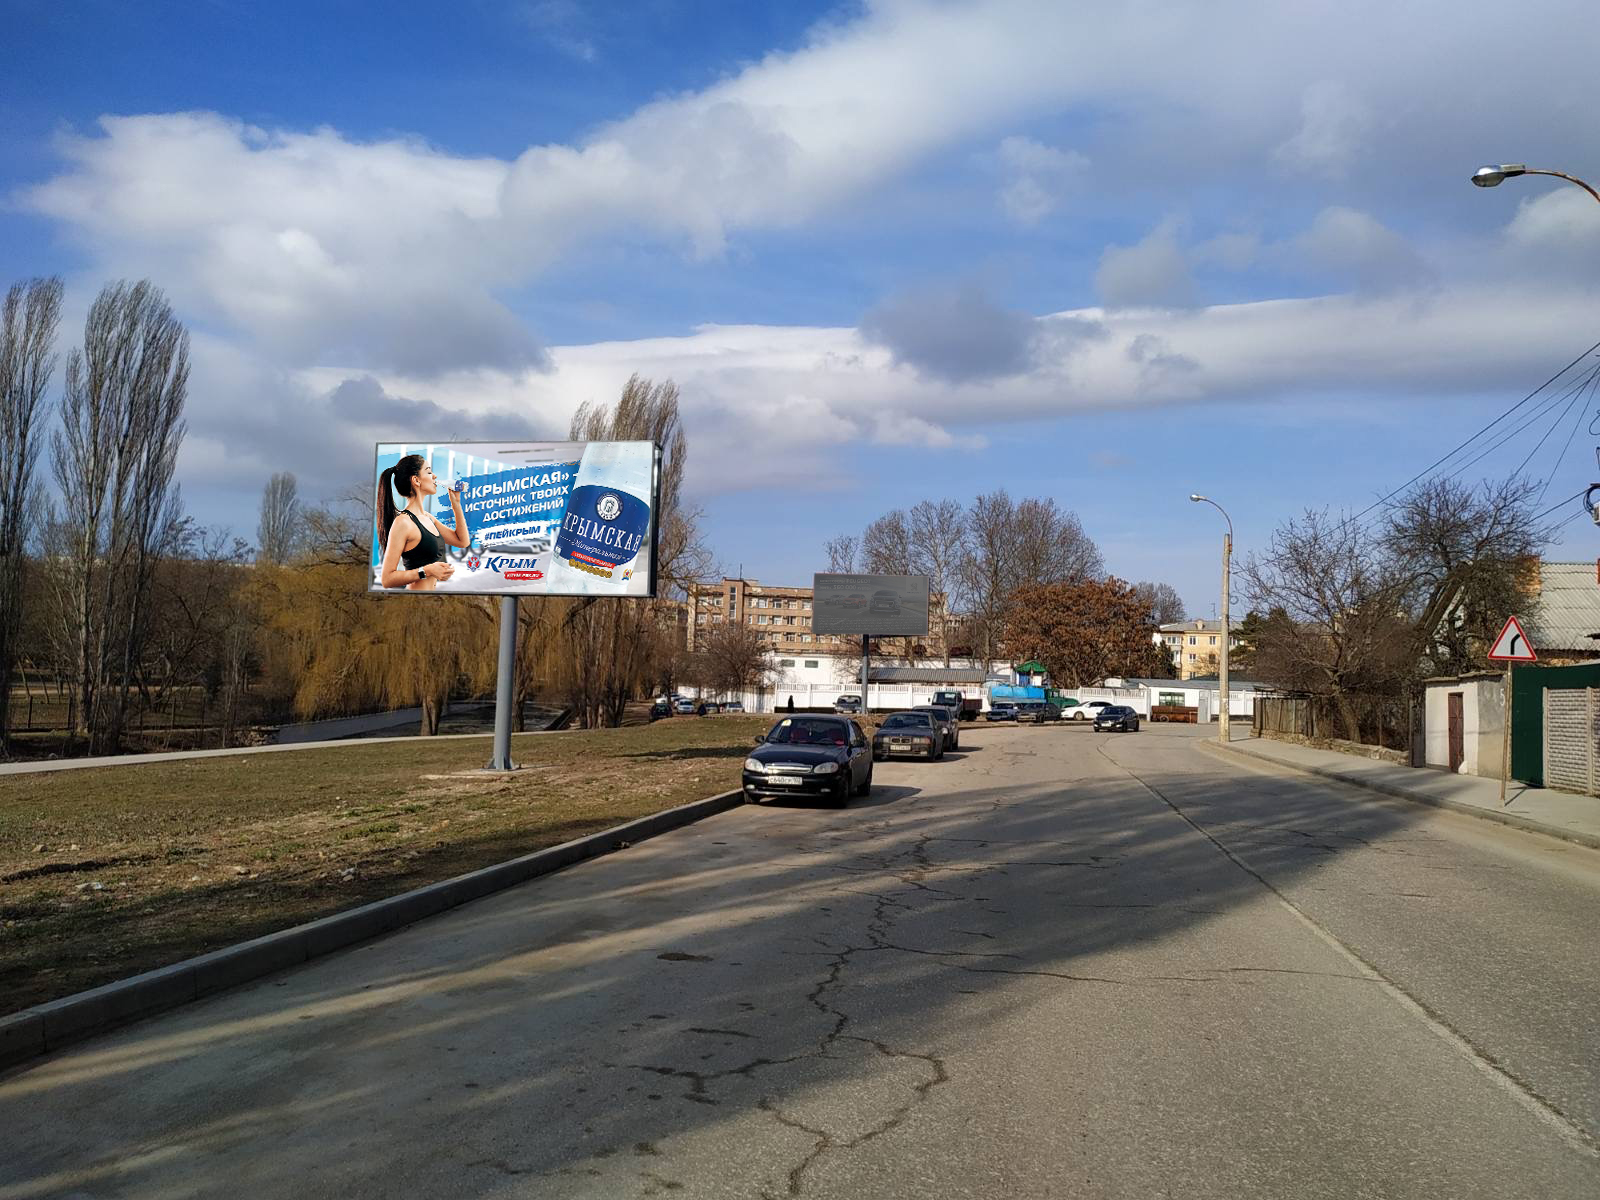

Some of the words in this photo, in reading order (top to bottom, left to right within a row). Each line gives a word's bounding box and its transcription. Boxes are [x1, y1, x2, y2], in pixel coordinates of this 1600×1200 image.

[464, 471, 570, 500] «КРЫМСКАЯ»
[465, 493, 526, 513] ИСТОЧНИК
[530, 485, 569, 501] ТВОИХ
[482, 497, 564, 522] ДОСТИЖЕНИЙ
[484, 526, 541, 541] #ПЕЙКРЫМ
[563, 512, 642, 552] КРЫМСКАЯ
